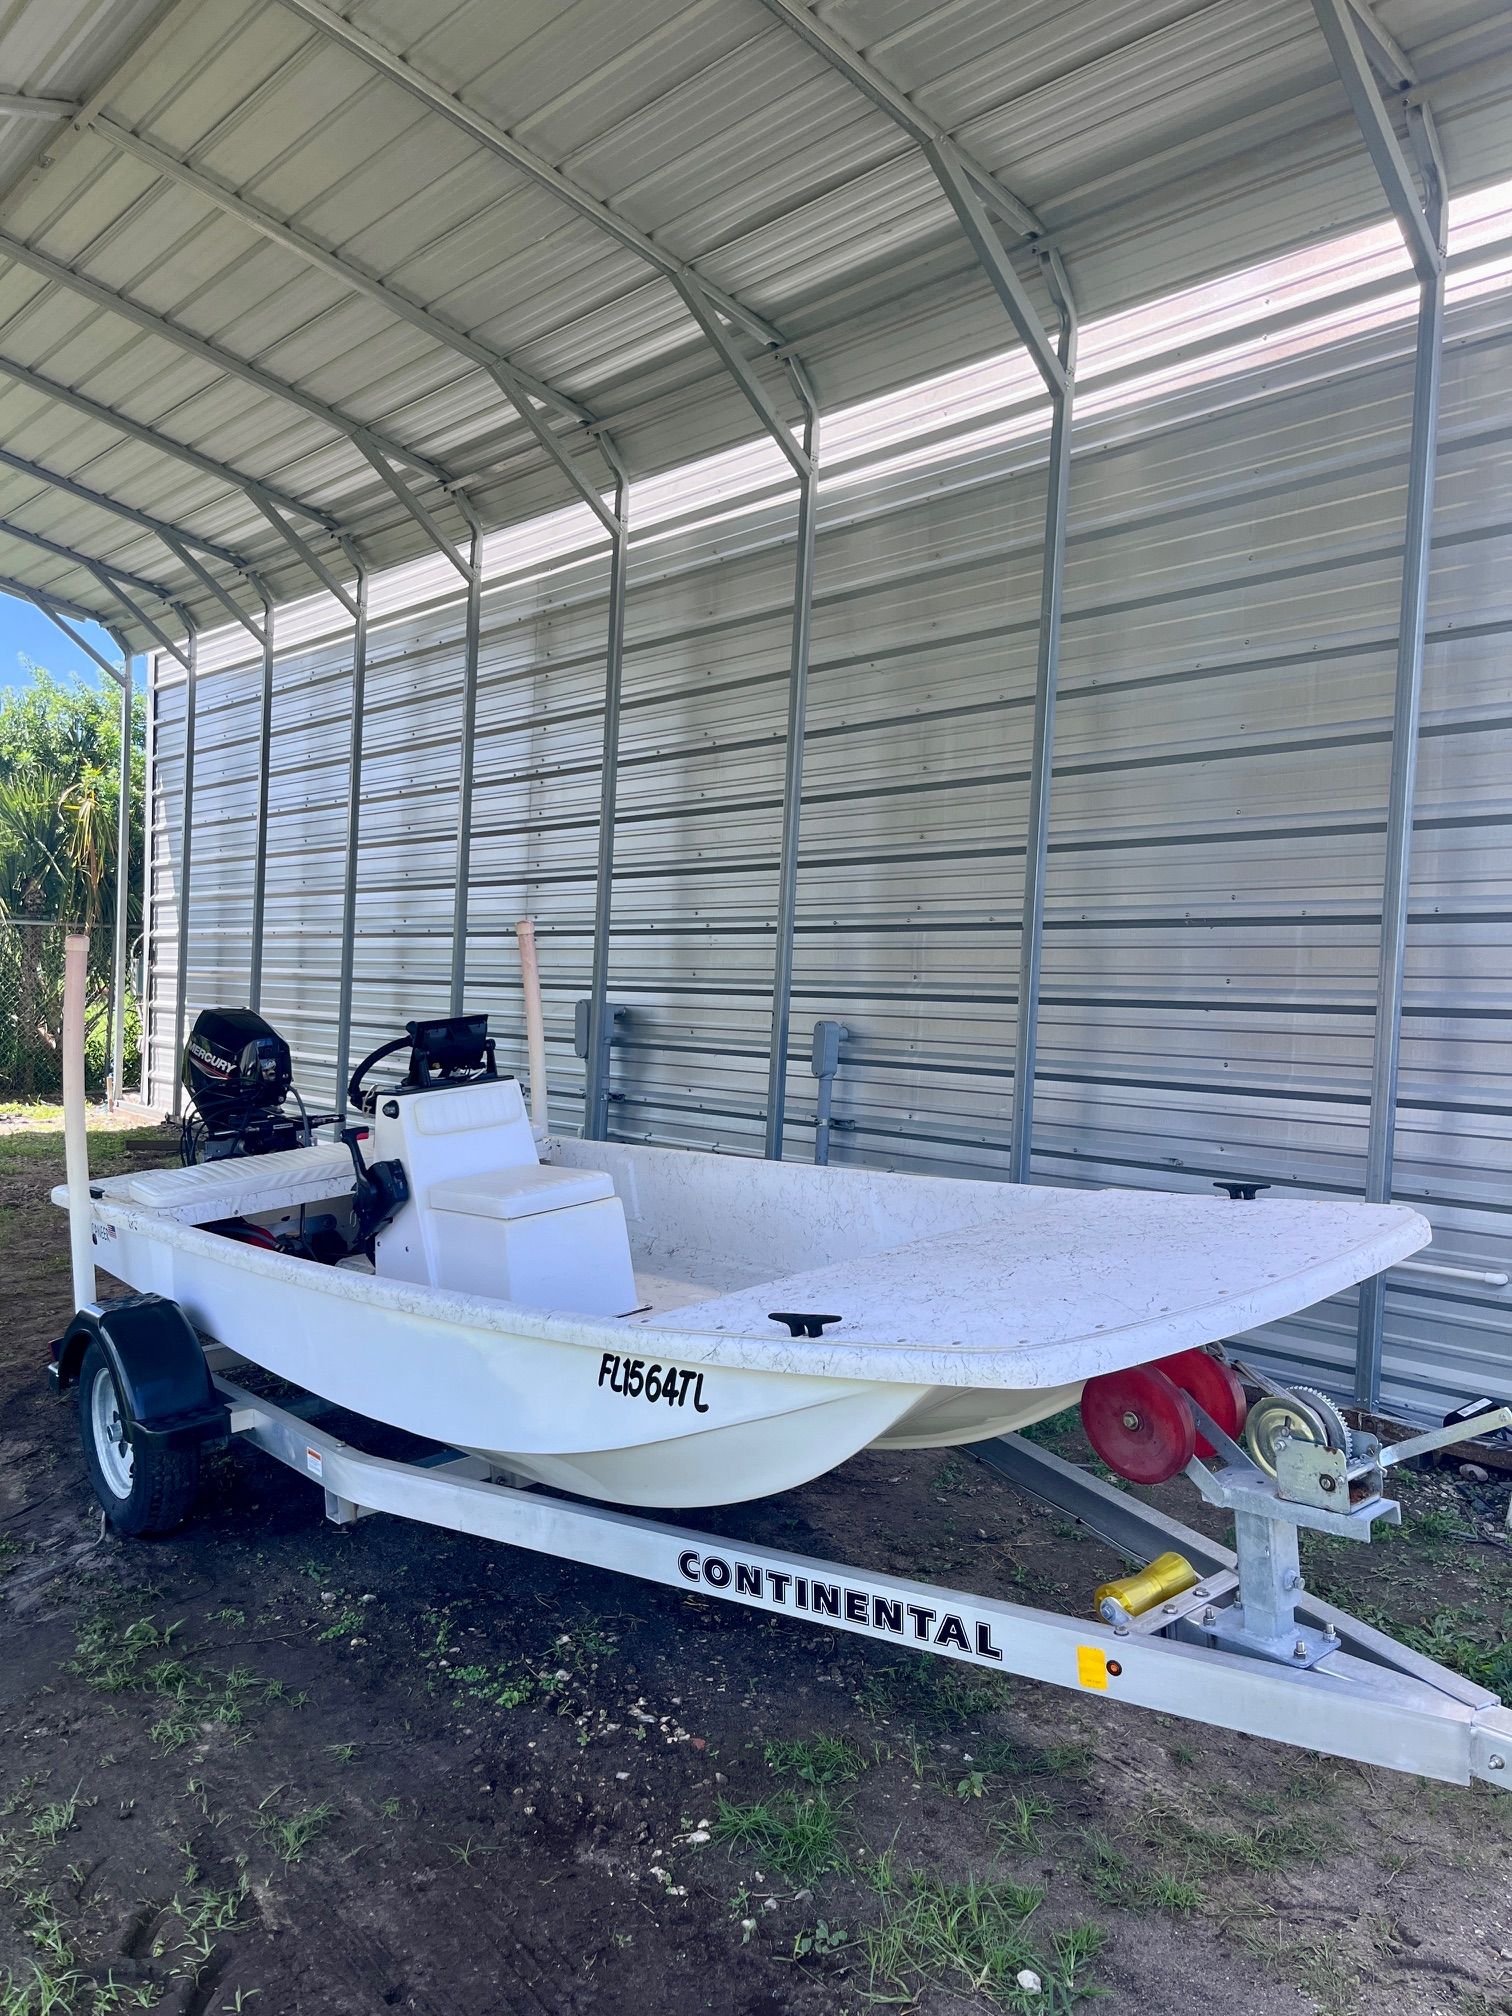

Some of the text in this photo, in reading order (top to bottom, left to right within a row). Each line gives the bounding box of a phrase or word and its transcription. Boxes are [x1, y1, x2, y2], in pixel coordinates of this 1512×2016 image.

[188, 1040, 237, 1073] MERCURY
[598, 1352, 709, 1413] FL1564TL
[677, 1549, 1003, 1661] CONTINENTAL
